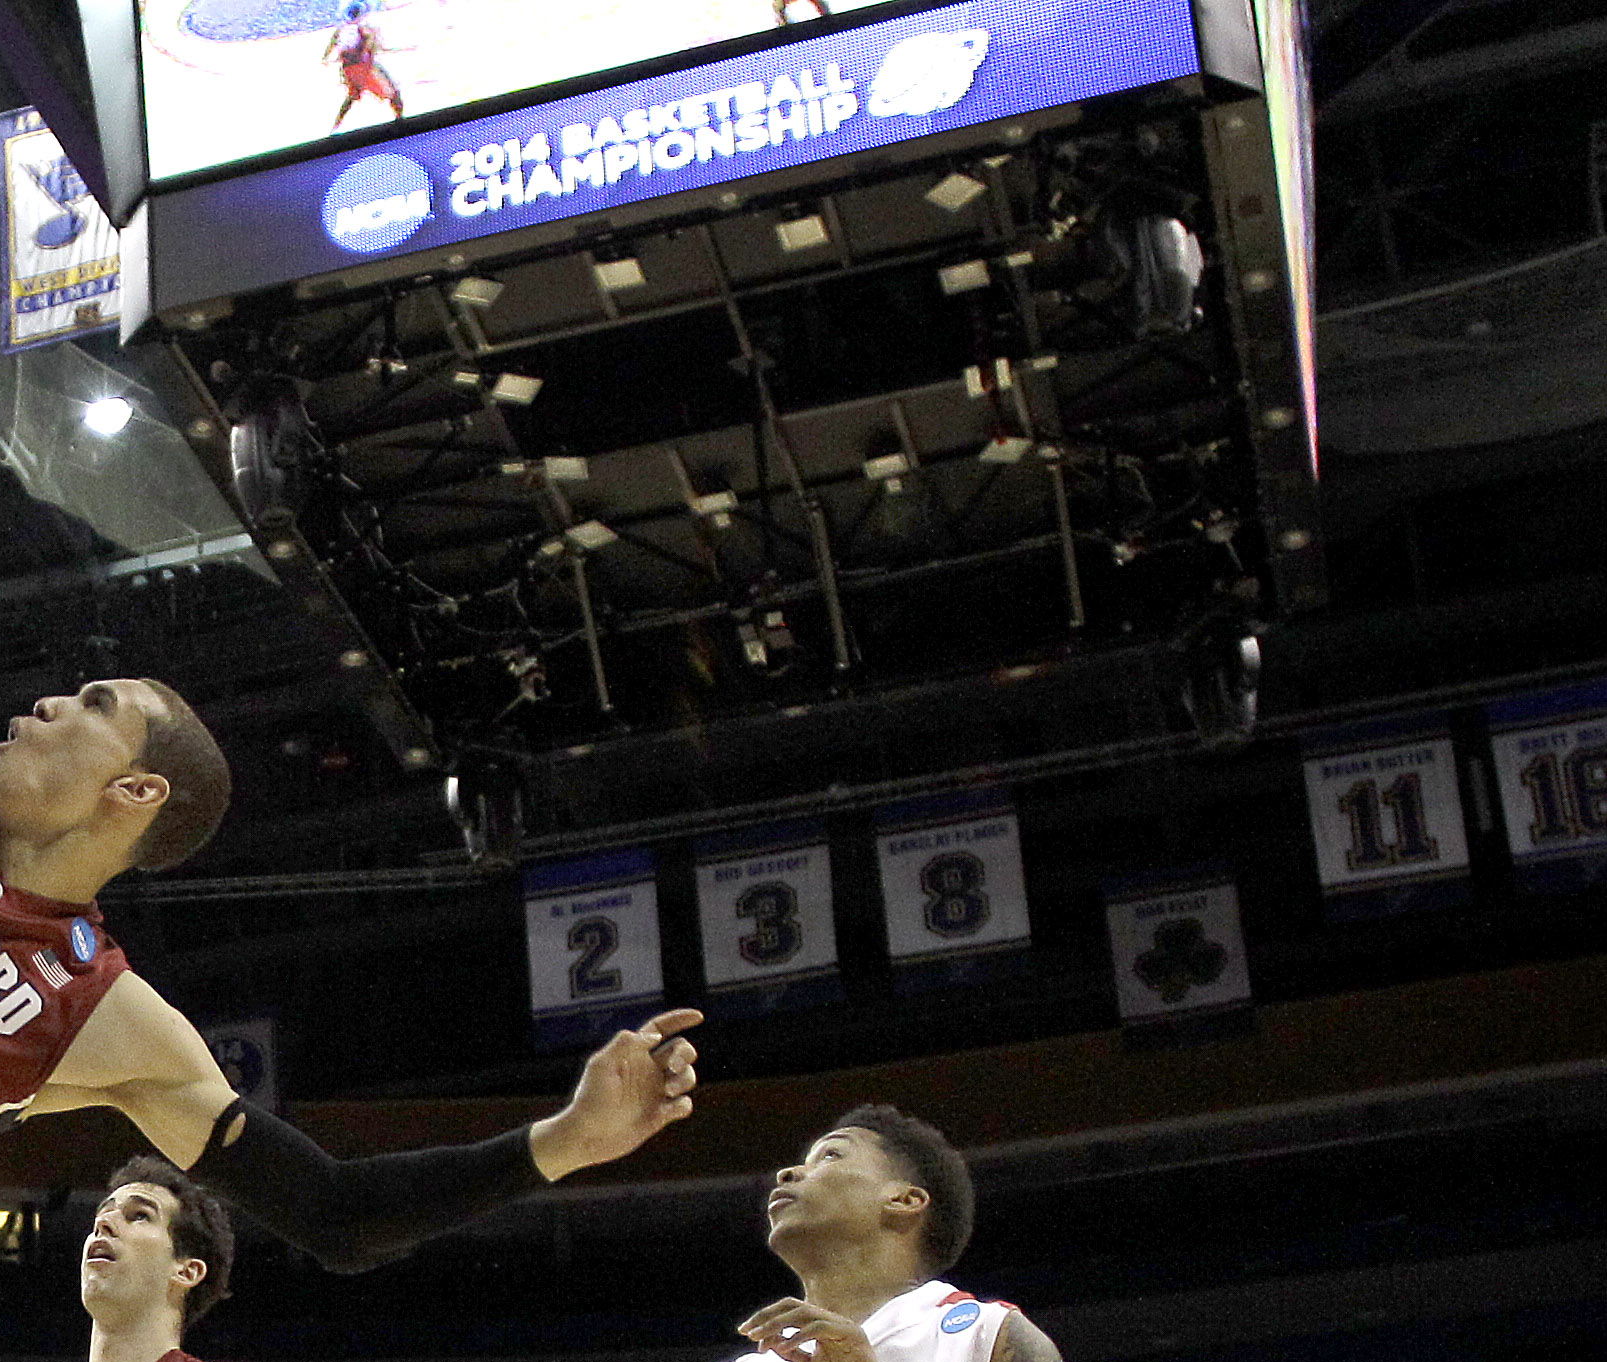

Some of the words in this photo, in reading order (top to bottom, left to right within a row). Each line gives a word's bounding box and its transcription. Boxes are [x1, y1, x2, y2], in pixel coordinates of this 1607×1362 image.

[449, 133, 551, 183] 2014
[561, 64, 854, 154] BASKETBALL
[451, 93, 858, 215] CHAMPIONSHIP
[22, 268, 70, 293] WEST
[1336, 772, 1440, 870] 11
[736, 881, 803, 967] 3
[920, 851, 991, 938] 8
[568, 915, 622, 999] 2
